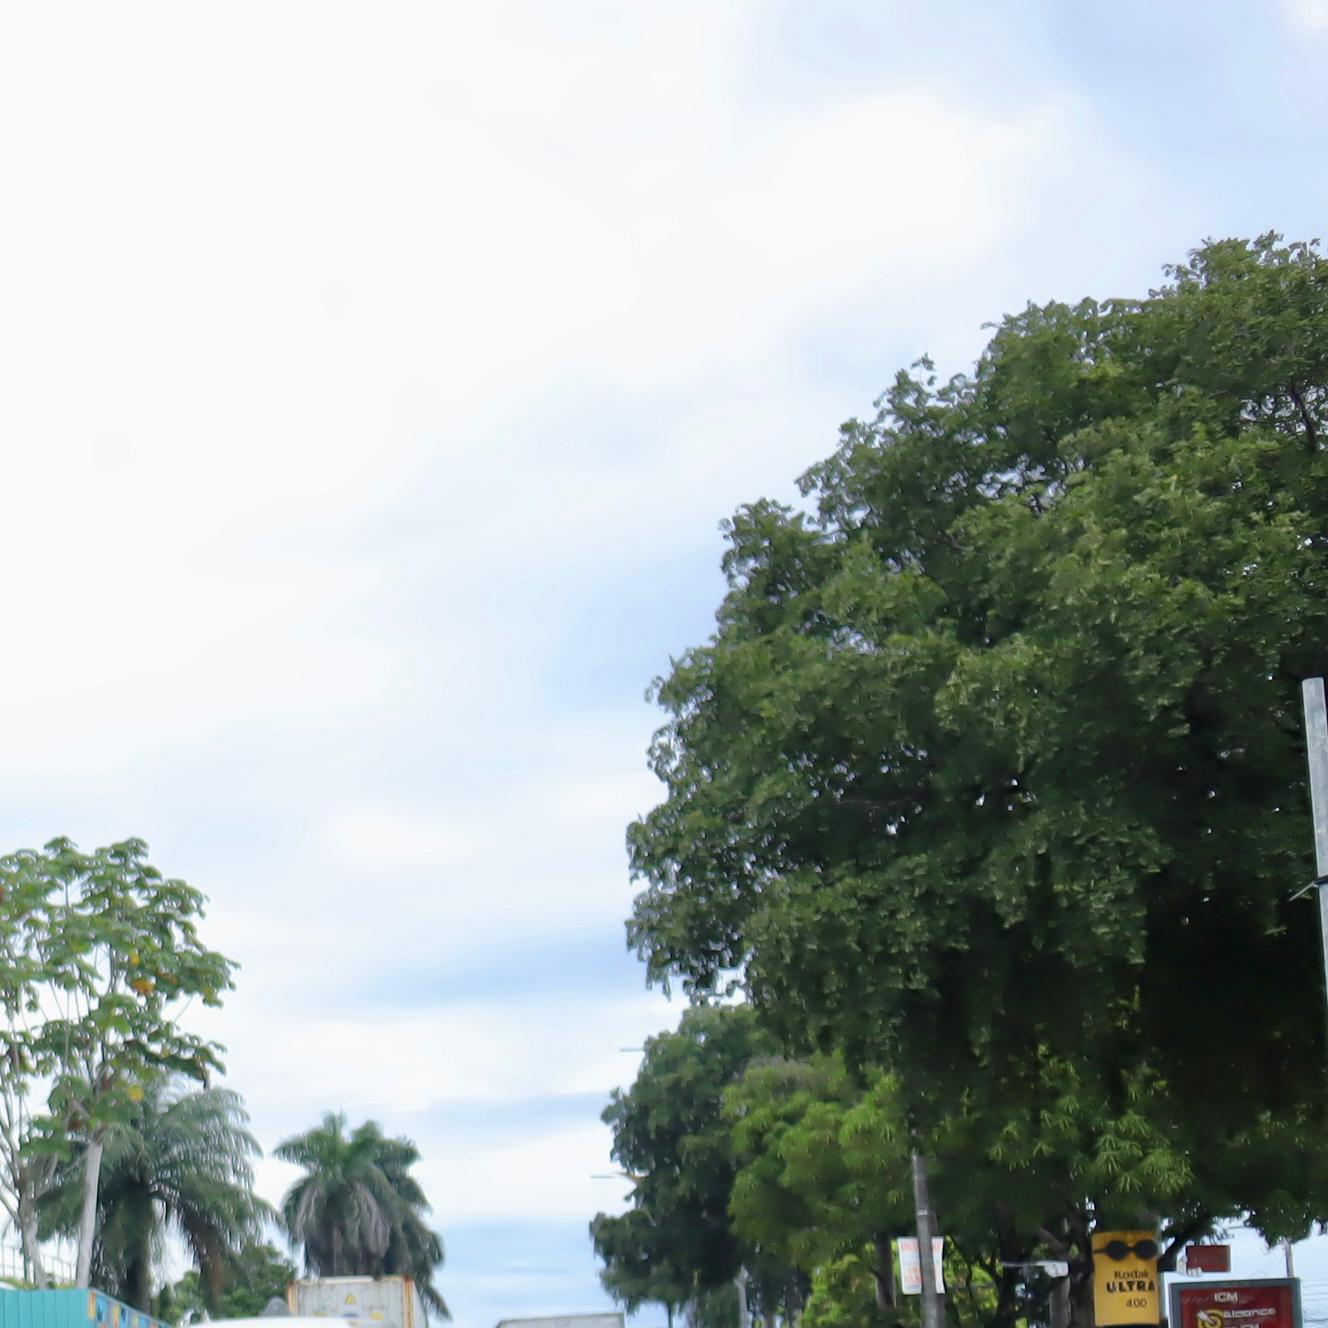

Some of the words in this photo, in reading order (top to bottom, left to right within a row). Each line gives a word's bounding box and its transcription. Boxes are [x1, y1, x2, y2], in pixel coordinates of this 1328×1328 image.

[1106, 1281, 1156, 1293] ULTRA
[1126, 1298, 1148, 1308] 400
[1214, 1292, 1239, 1303] ICM
